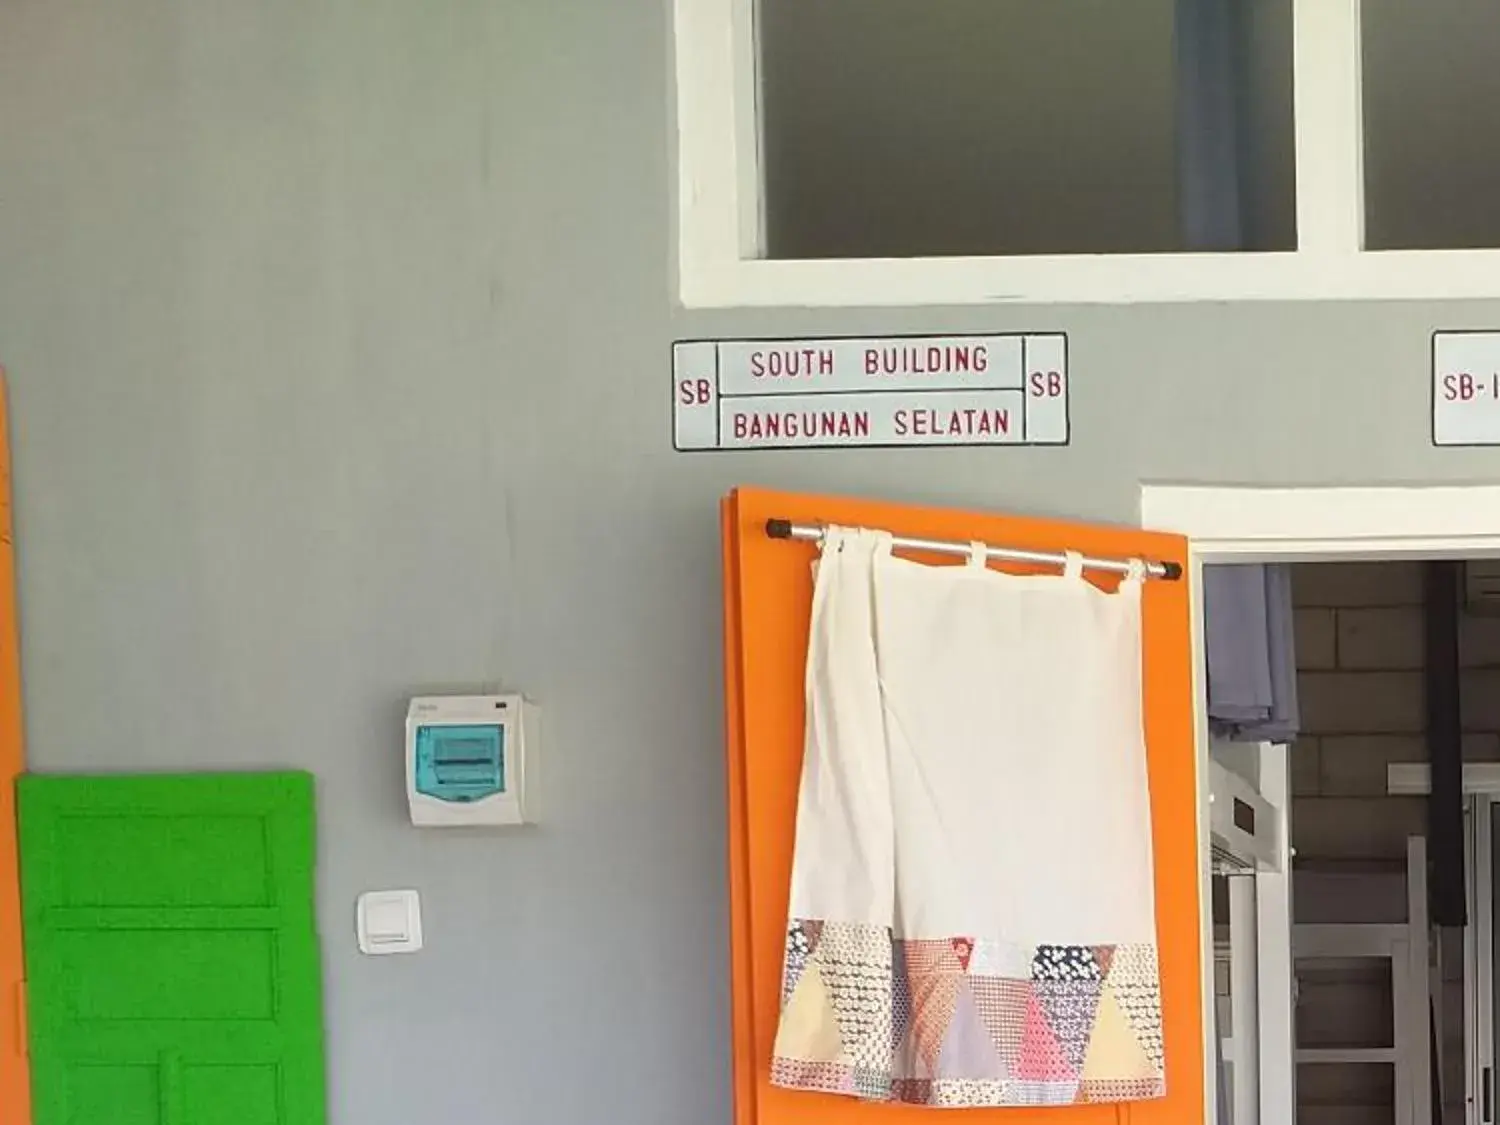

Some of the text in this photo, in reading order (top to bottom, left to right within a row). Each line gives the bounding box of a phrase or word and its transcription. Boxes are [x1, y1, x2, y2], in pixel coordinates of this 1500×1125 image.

[751, 346, 988, 377] SOUTH BUILDING
[680, 379, 712, 405] SB
[1031, 372, 1062, 398] SB
[734, 409, 1010, 439] BANGUNAN SELATAN
